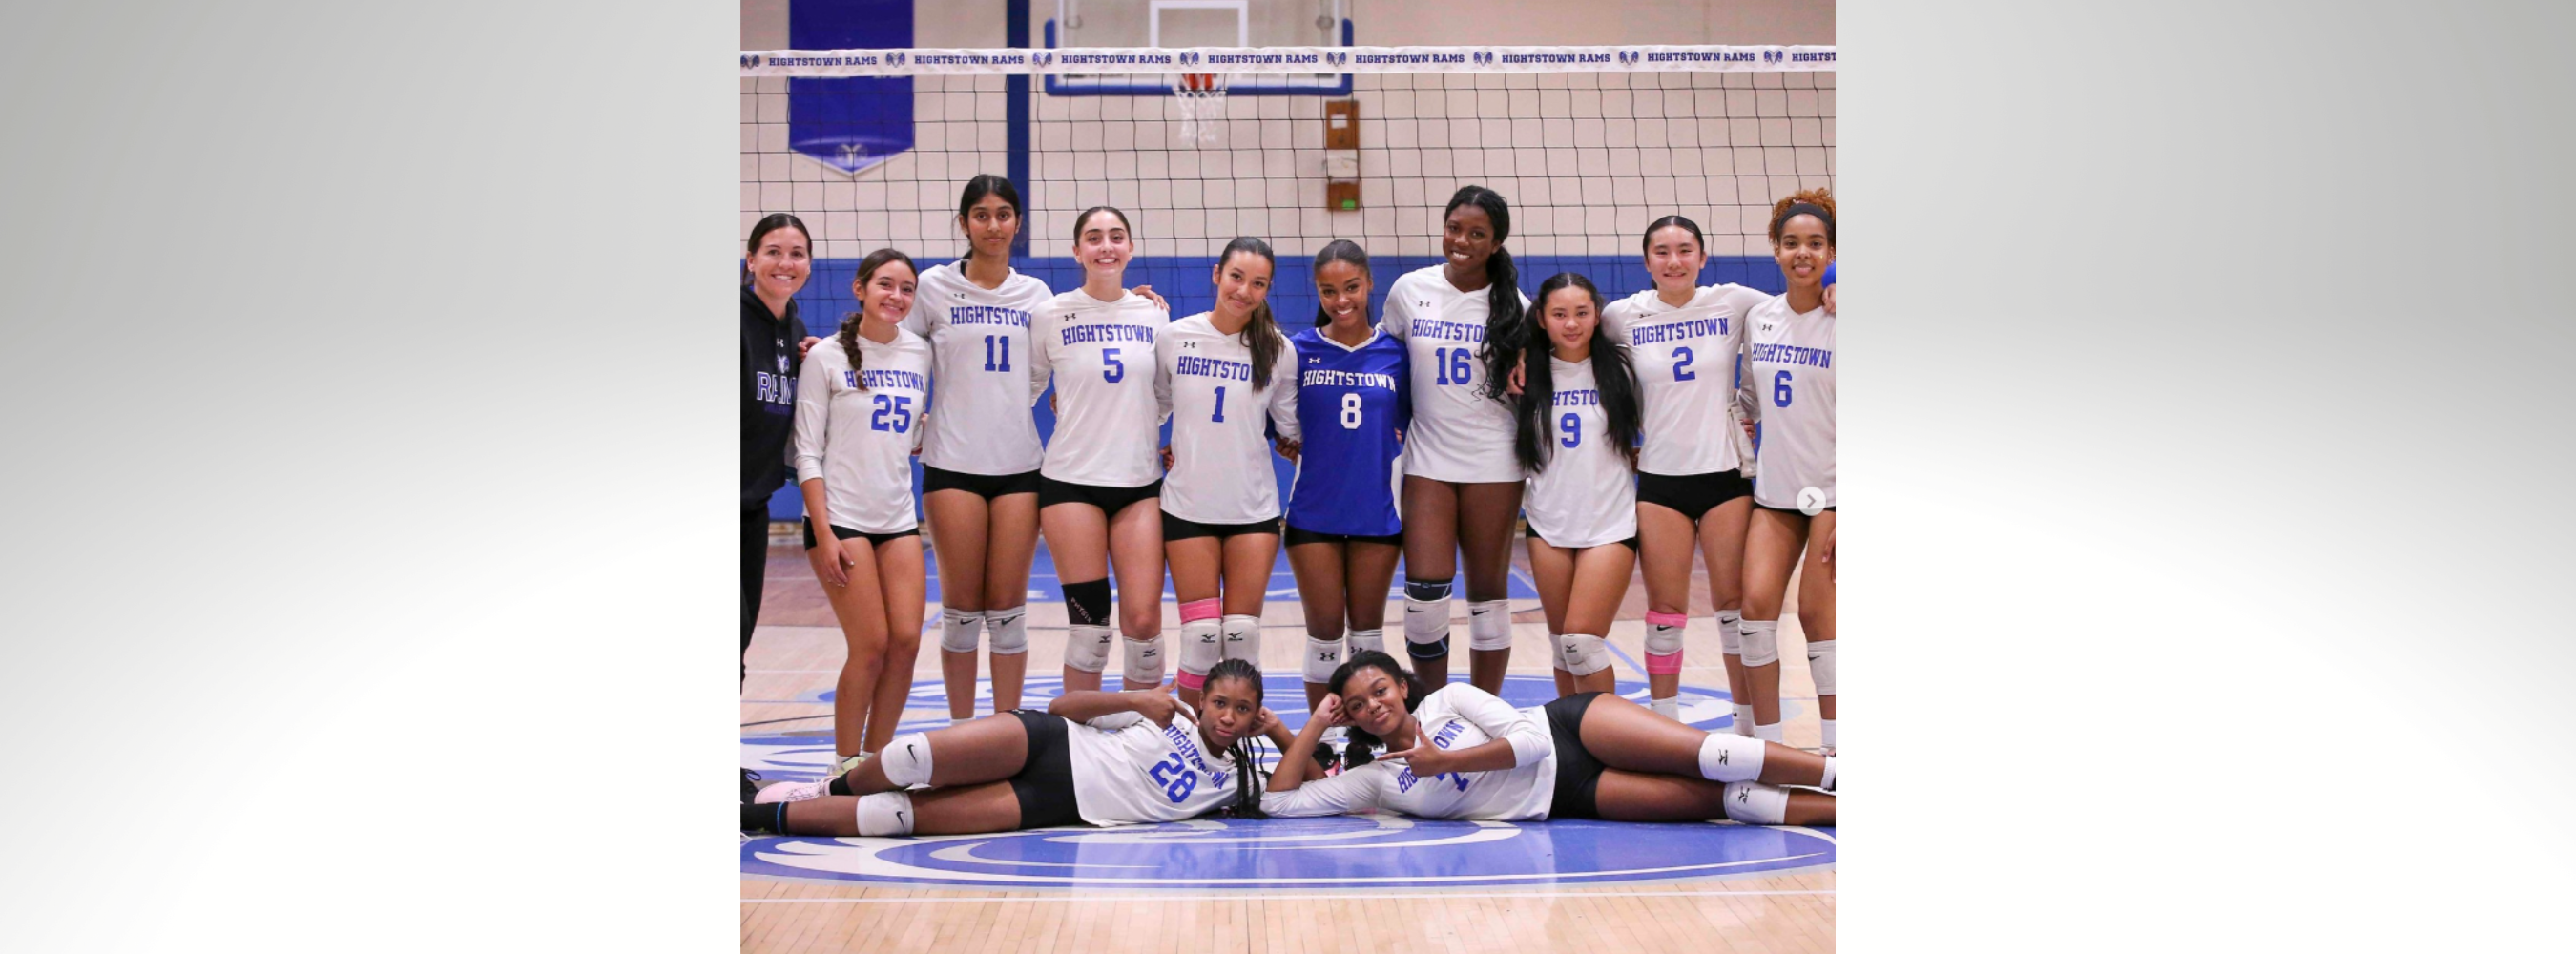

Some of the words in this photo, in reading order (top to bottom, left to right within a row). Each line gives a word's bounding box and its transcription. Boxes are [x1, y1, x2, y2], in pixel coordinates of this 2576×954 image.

[769, 56, 841, 66] HIGHTSTOWN
[845, 55, 877, 66] RAMS
[914, 55, 988, 65] HIGHTSTOWN
[991, 55, 1025, 65] RAMS
[1061, 54, 1136, 64] HIGHTSTOWN
[1138, 54, 1172, 64] RAMS
[1208, 54, 1282, 64] HIGHTSTOWN
[1285, 54, 1319, 64] RAMS
[1355, 54, 1429, 64] HIGHTSTOWN
[1432, 54, 1465, 64] RAMS
[1502, 53, 1575, 64] HIGHTSTOWN
[1578, 53, 1610, 63] RAMS
[1647, 52, 1720, 62] HIGHTSTOWN
[1723, 52, 1755, 62] RAMS
[1061, 324, 1154, 346] HIGHTSTOWN
[1412, 318, 1491, 343] HIGHTSTO
[1632, 317, 1729, 346] HIGHTSTOWN
[984, 335, 1011, 373] 11
[1102, 347, 1125, 384] 5
[1435, 347, 1473, 386] 16
[1672, 346, 1696, 383] 2
[1752, 342, 1832, 370] HIGHTSTOWN
[844, 369, 924, 393] HGHTSTOWN
[1176, 355, 1270, 386] HIGHTSTO
[1302, 369, 1397, 393] HIGHTSTOWN
[1773, 369, 1794, 408] 6
[870, 394, 912, 434] 25
[1211, 385, 1226, 424] 1
[1340, 392, 1362, 430] 8
[1560, 411, 1582, 449] 9
[1149, 752, 1198, 803] 28
